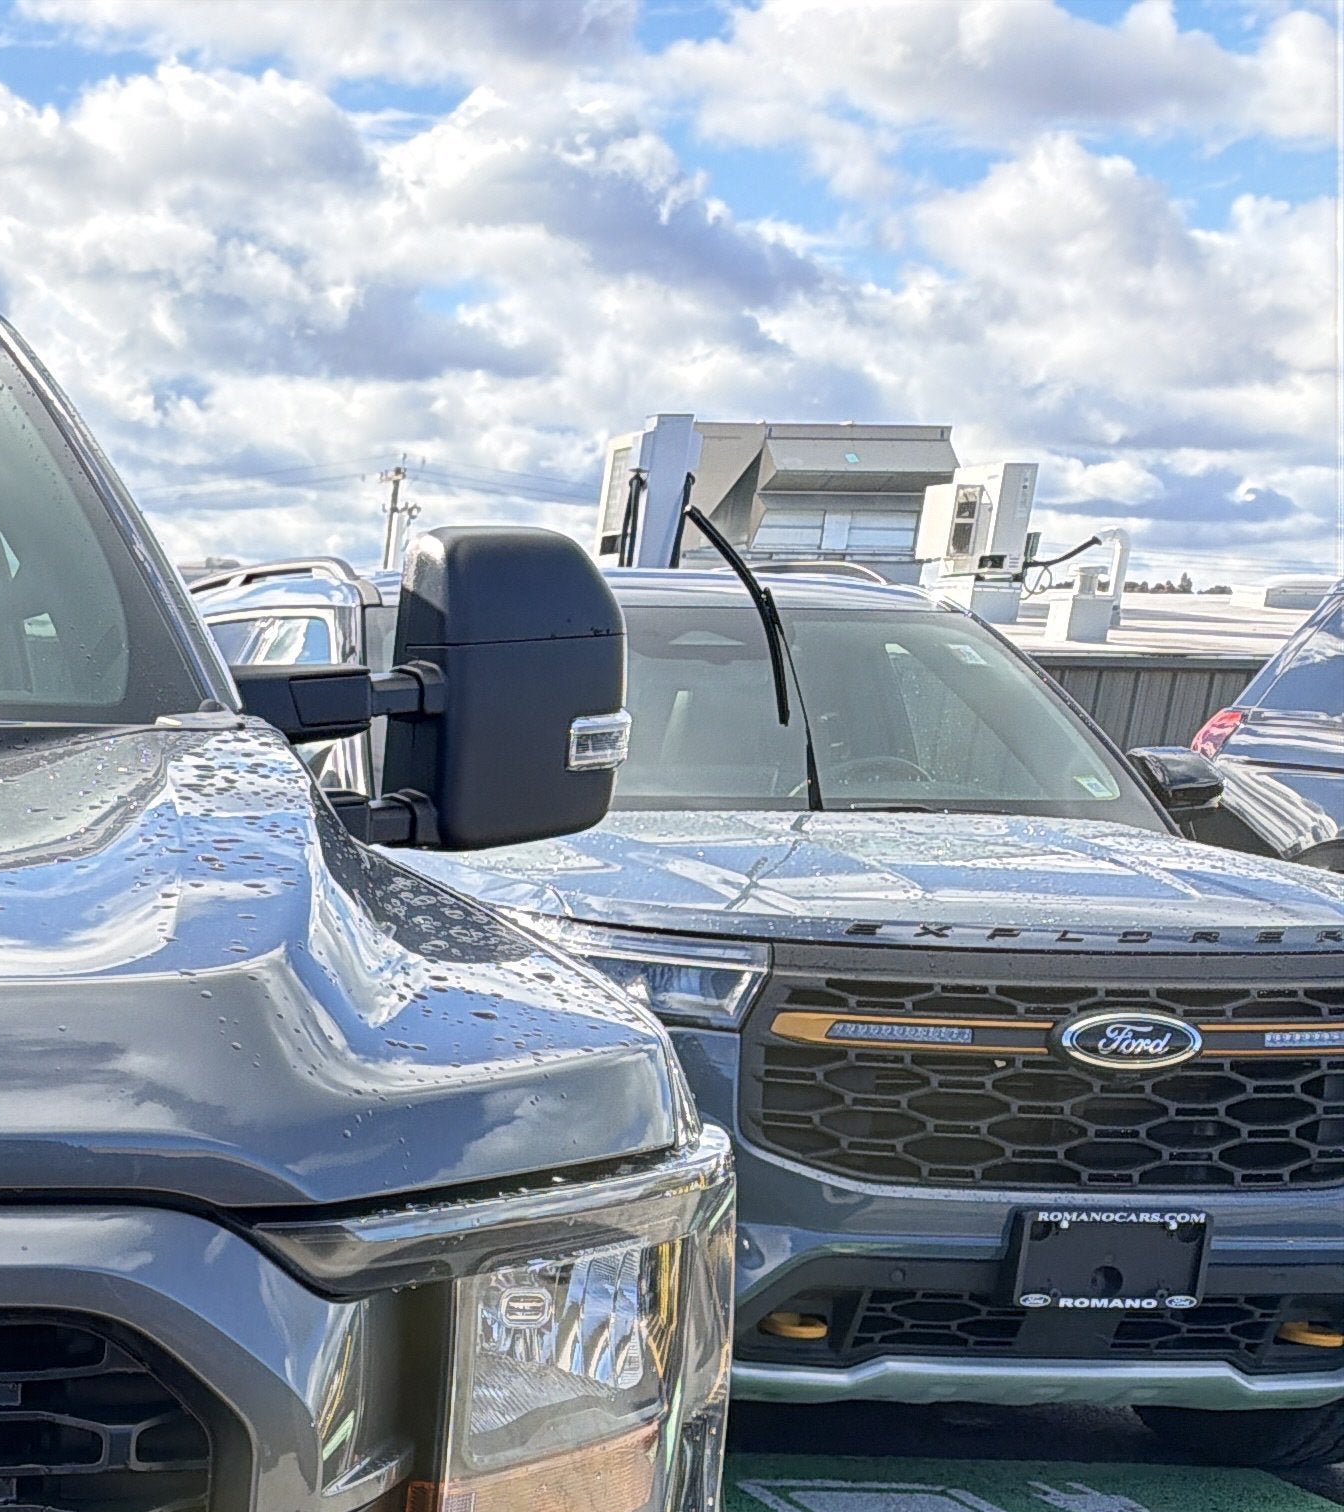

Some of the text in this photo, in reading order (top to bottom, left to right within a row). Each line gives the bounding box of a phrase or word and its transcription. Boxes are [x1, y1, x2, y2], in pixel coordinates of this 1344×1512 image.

[844, 921, 1344, 944] EXPLORER
[1097, 1023, 1172, 1056] Ford
[1037, 1211, 1206, 1223] ROMANOCARS.COM
[1058, 1297, 1158, 1309] ROMANO
